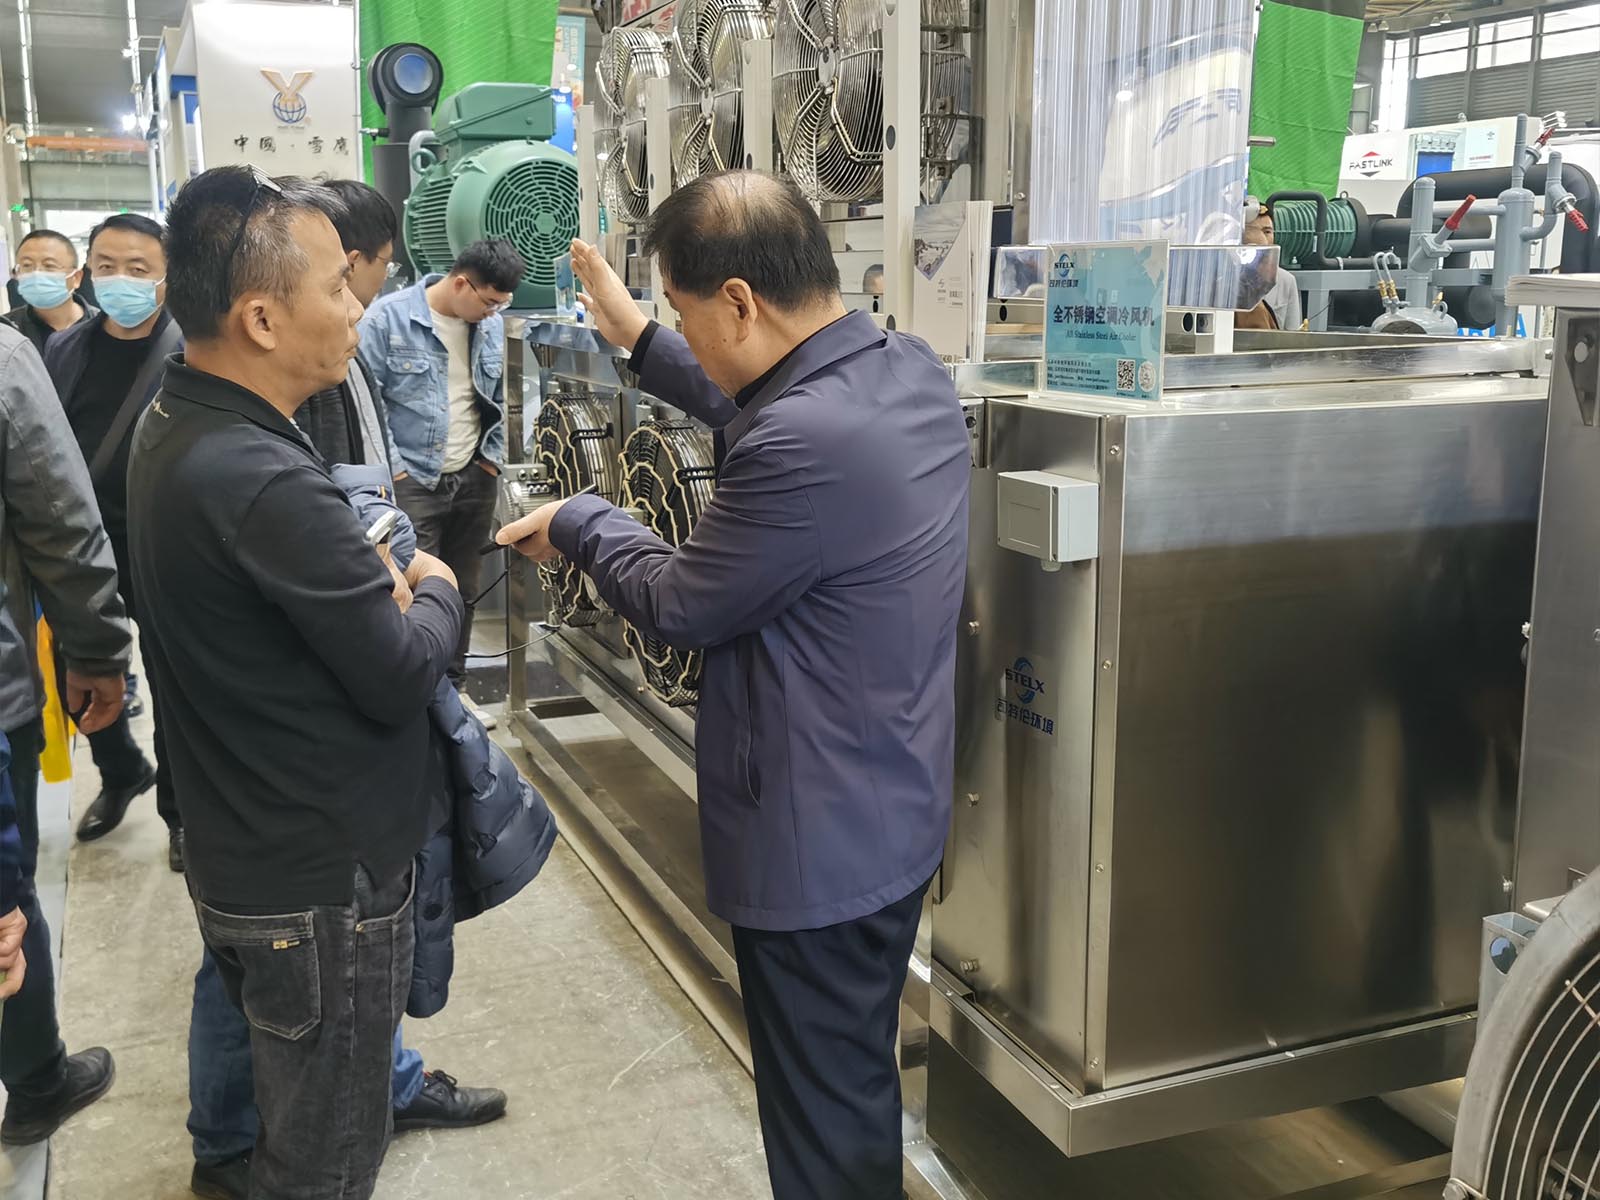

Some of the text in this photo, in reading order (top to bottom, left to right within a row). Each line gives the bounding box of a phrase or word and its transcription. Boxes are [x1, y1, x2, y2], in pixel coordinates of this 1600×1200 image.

[1349, 158, 1393, 170] FASTLINK
[1053, 304, 1155, 326] 全不锈钢空调冷风机
[1109, 332, 1118, 340] Air
[1005, 668, 1045, 693] STELX
